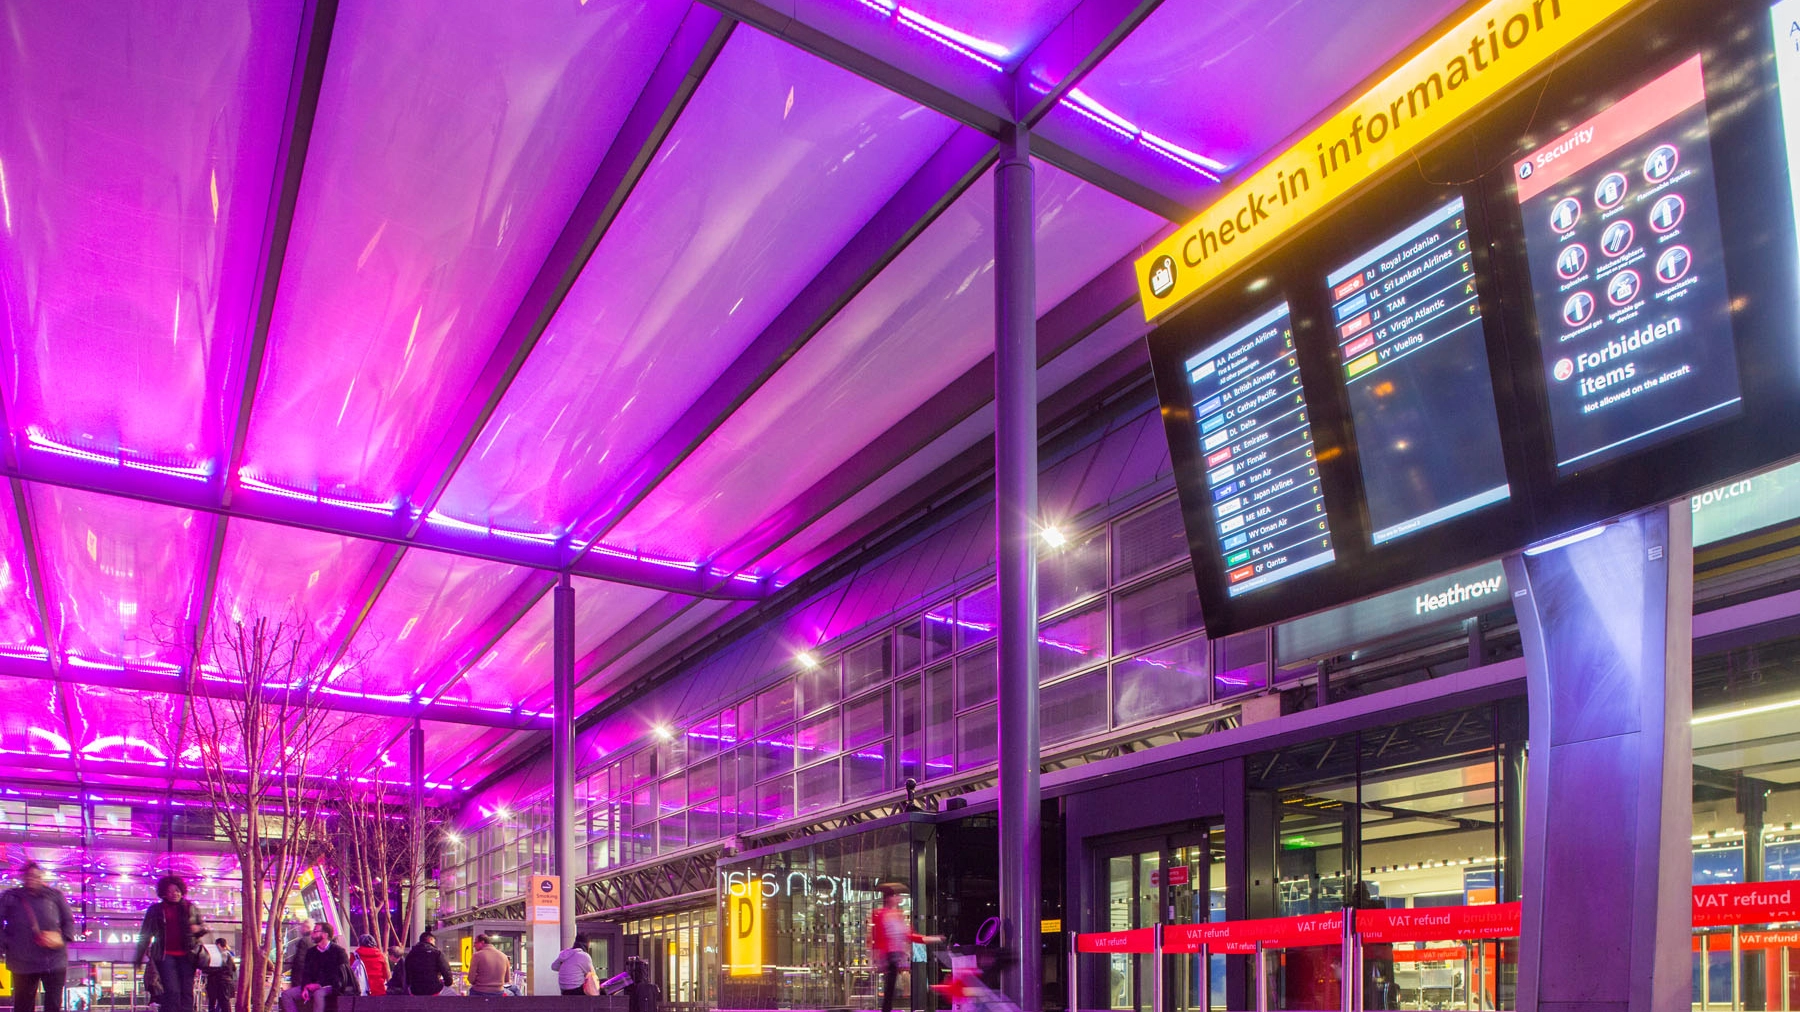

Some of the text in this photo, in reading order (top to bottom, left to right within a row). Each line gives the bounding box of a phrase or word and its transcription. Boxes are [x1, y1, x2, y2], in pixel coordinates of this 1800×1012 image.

[1182, 0, 1562, 269] Check-in information
[1536, 126, 1594, 168] Security
[1637, 180, 1670, 201] Flammable
[1366, 219, 1462, 281] RJ Royal Jordanian F
[1370, 240, 1466, 300] UL Sri Lankan Airlines G
[1373, 262, 1469, 320] JJ TAM E
[1667, 289, 1688, 302] sprays
[1376, 284, 1474, 340] VS Virgin Atlantic A
[1216, 328, 1291, 368] AA American Airlines H
[1286, 339, 1293, 348] E
[1380, 305, 1476, 359] VY Vueling F
[1577, 317, 1681, 373] Forbidden
[1223, 358, 1296, 402] BA British Airways D
[1226, 376, 1299, 419] CX Cathay Pacific C
[1581, 363, 1635, 396] items
[1584, 365, 1690, 413] Not allowed on the aircraft
[1229, 395, 1303, 437] DL Delta A
[1232, 412, 1306, 454] EK Emirates E
[1236, 431, 1309, 471] AY Finnair F
[1250, 473, 1262, 483] Iran
[1263, 468, 1272, 478] Air
[1305, 449, 1312, 458] G
[1242, 468, 1315, 506] JL Japan Airlines D
[1246, 486, 1318, 523] ME MEA F
[1249, 504, 1322, 539] WY Oman Air E
[1252, 547, 1261, 556] PK
[1263, 542, 1274, 552] PIA
[1319, 521, 1326, 531] G
[1256, 539, 1328, 573] QF Qantas F
[1416, 576, 1502, 614] Heathrow
[1694, 890, 1790, 907] VAT refund
[738, 897, 753, 939] D
[1187, 929, 1202, 939] VAT
[1204, 928, 1230, 938] refund
[1297, 921, 1317, 932] VAT
[1318, 918, 1342, 930] refun
[1389, 913, 1451, 926] VAT refund
[1095, 938, 1127, 947] VAT refund
[1226, 942, 1240, 950] VAT
[1740, 934, 1798, 944] VAT refund
